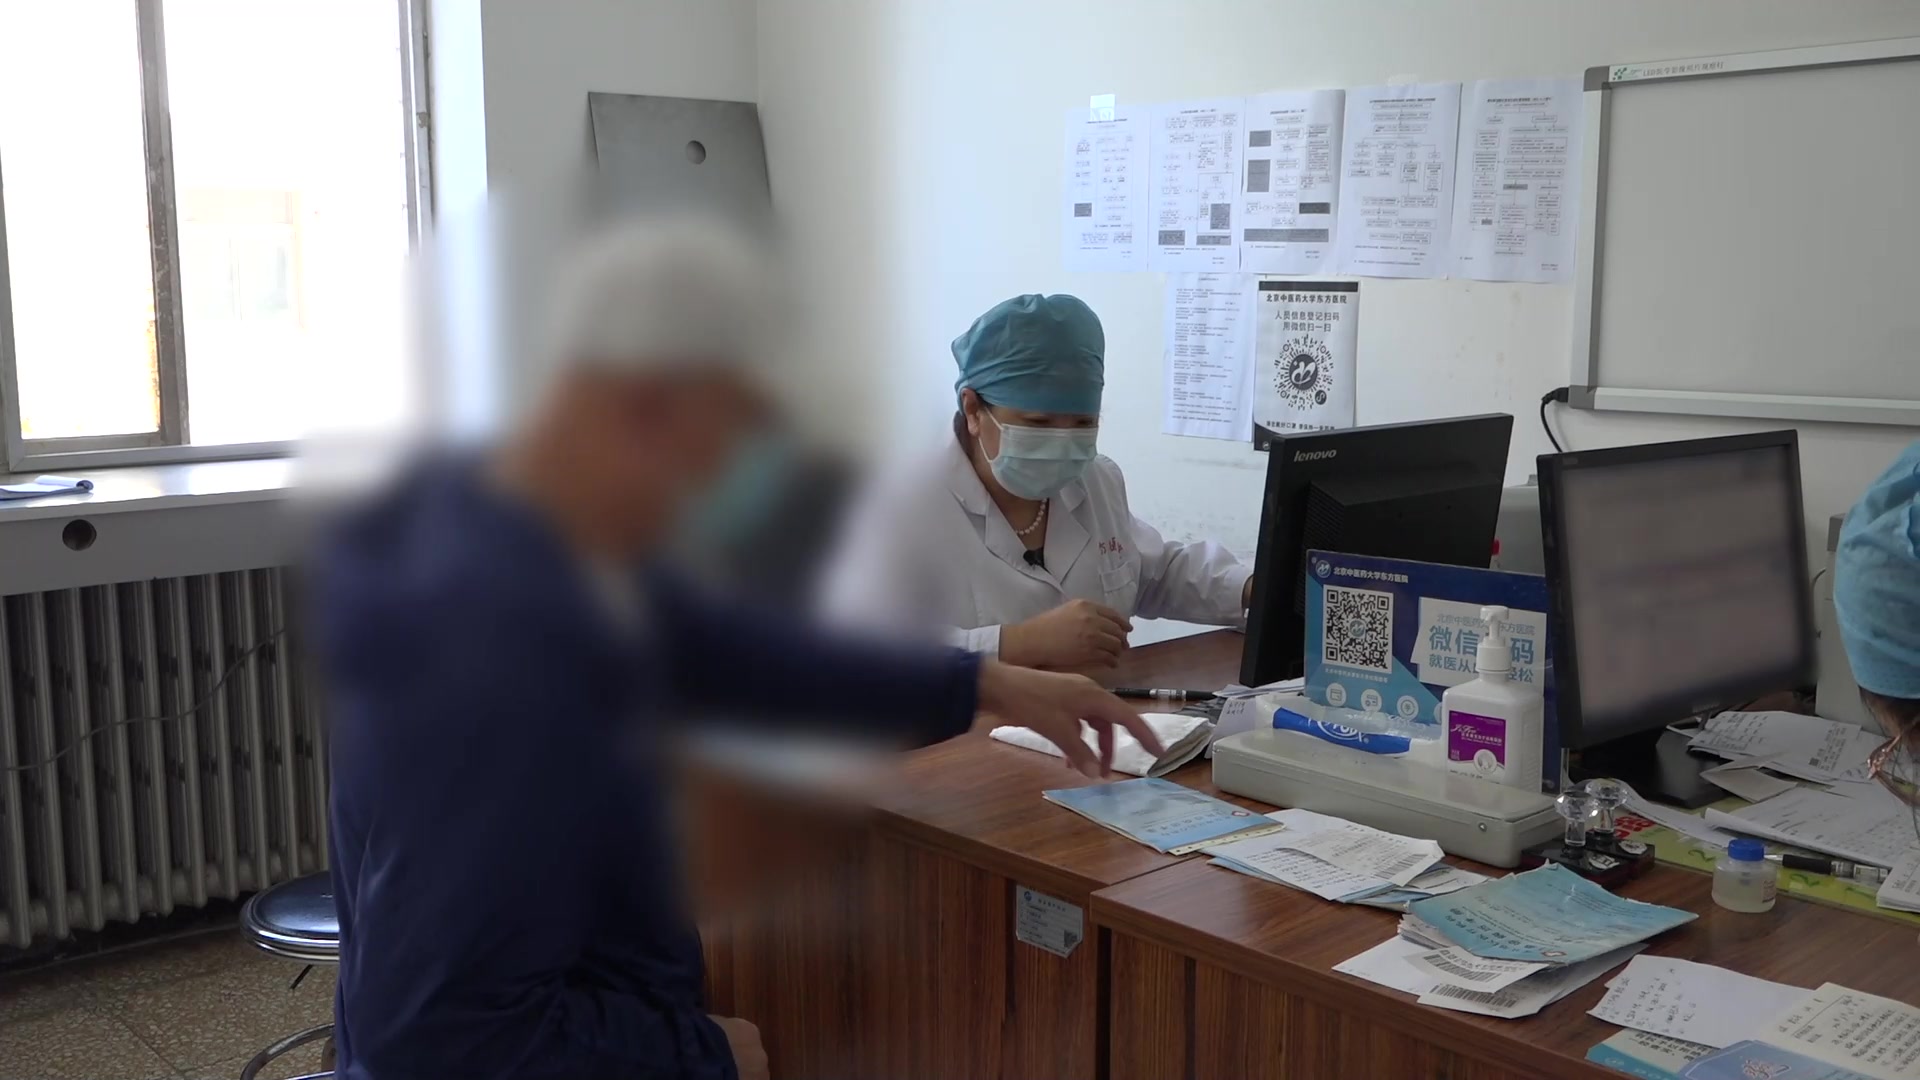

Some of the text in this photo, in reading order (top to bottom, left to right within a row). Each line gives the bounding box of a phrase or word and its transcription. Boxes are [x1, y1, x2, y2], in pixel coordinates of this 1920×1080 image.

[1266, 293, 1347, 304] 北京中医药大学东方医院
[1275, 310, 1340, 321] 人员信息登记扫码
[1283, 321, 1332, 332] 用微信扫一扫
[1333, 566, 1409, 584] 北京中医药大学东方医院
[1437, 613, 1536, 635] 北京中医药东方医院
[1429, 625, 1534, 664] 微信码
